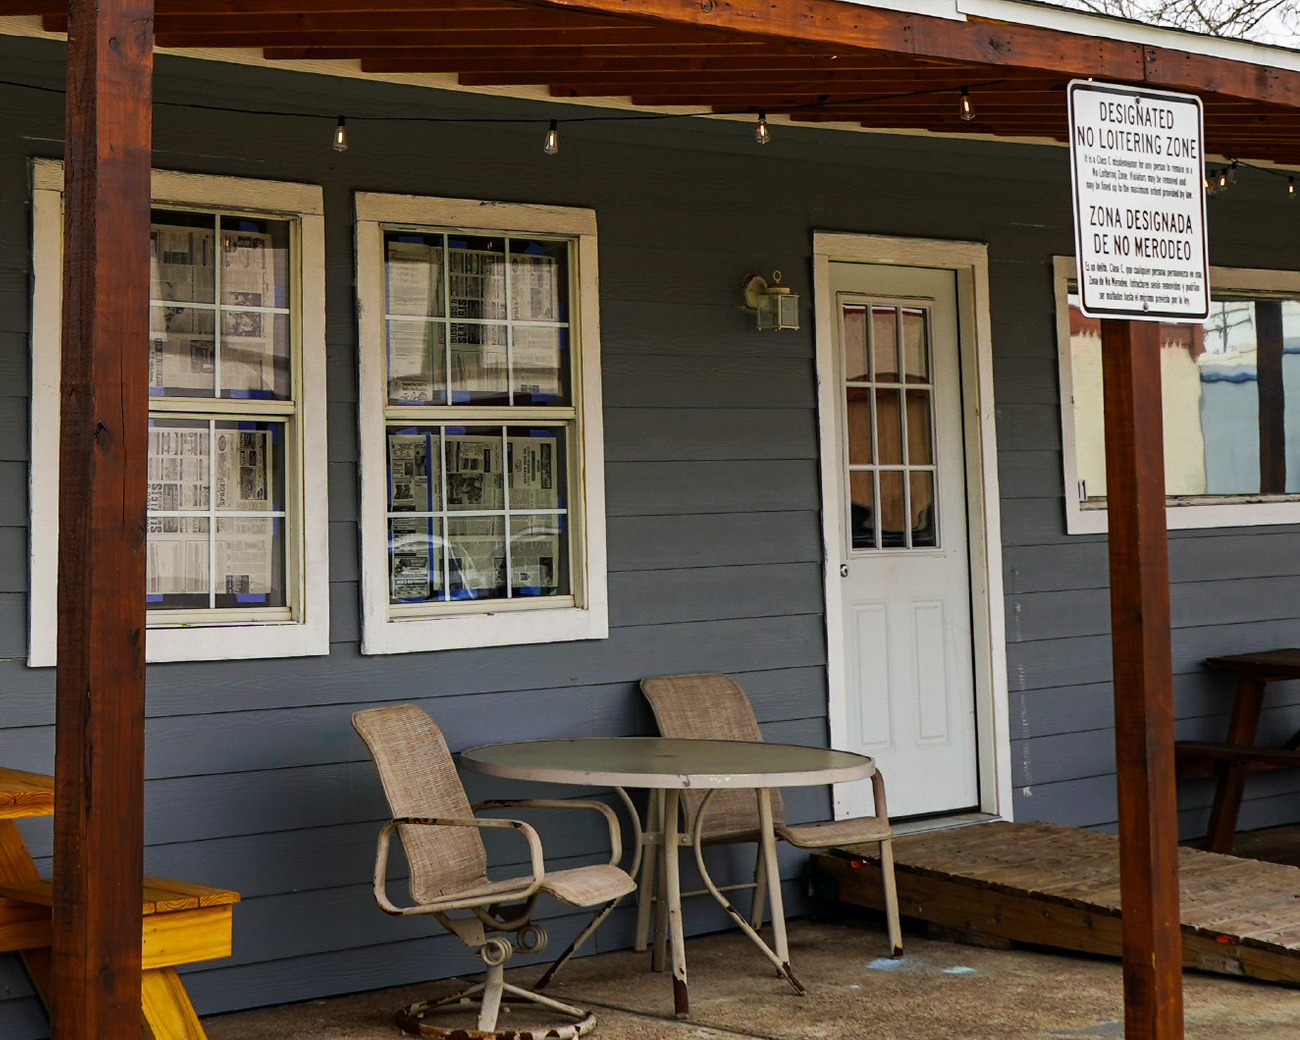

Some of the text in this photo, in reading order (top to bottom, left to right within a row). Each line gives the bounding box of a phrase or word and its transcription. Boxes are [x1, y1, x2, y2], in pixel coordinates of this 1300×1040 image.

[1099, 101, 1174, 130] DESIGNATED
[1077, 126, 1197, 159] NO LOITERING ZONE
[1089, 205, 1193, 234] ZONA DESIGNADA
[1093, 233, 1191, 260] DE NO MERODEO
